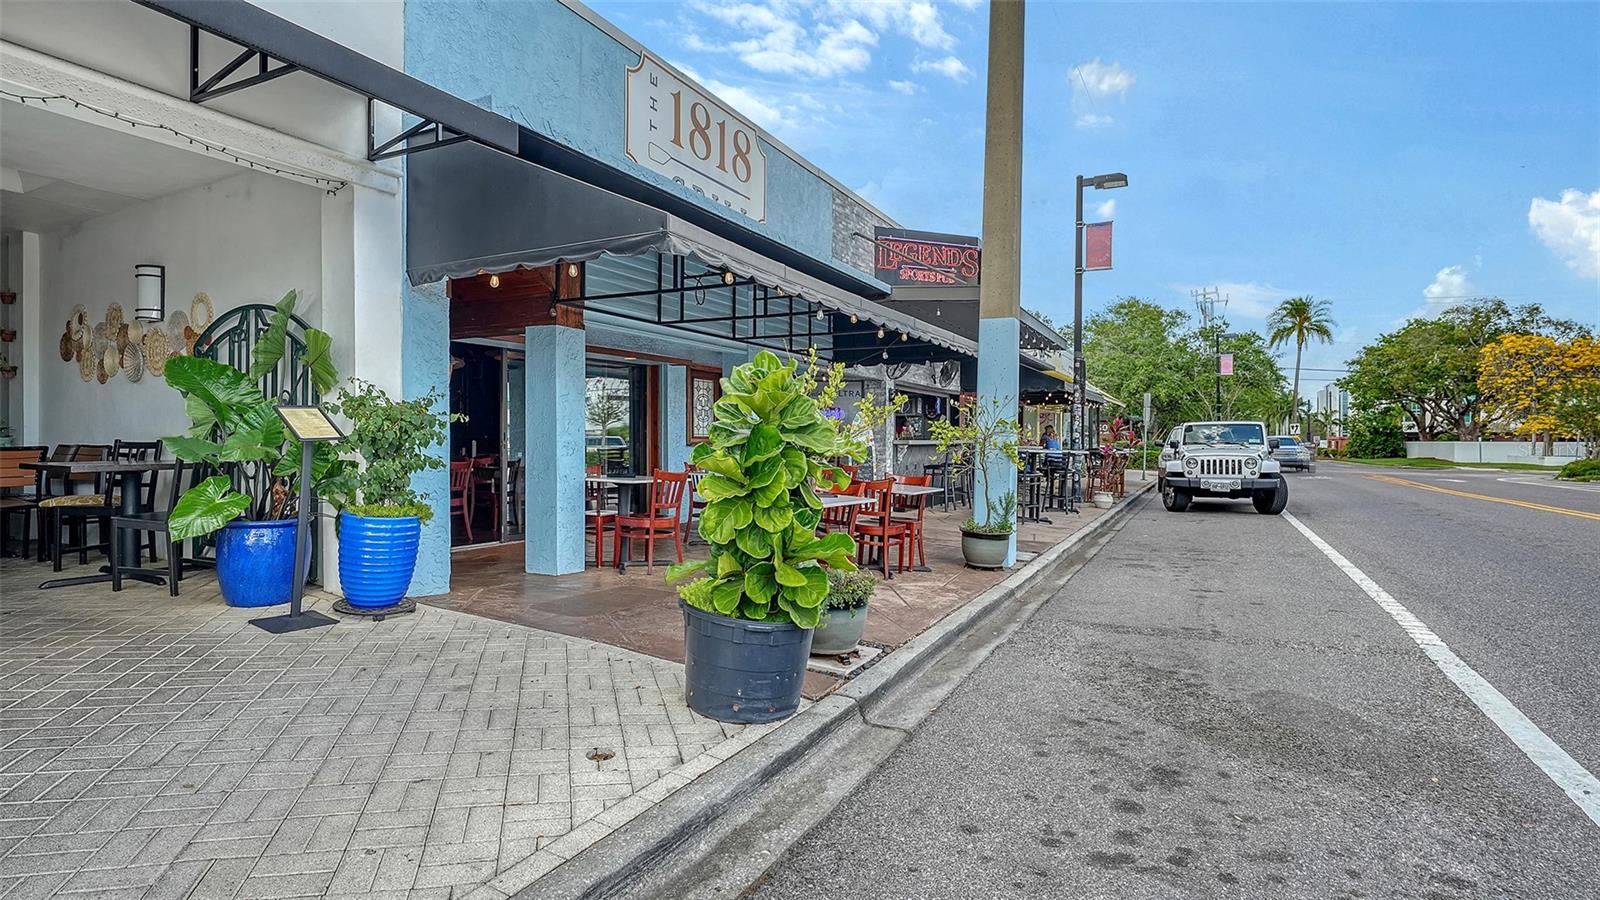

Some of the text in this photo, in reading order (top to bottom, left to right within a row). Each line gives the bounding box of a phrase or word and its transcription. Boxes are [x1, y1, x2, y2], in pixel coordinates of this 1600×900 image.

[649, 72, 659, 132] THE
[670, 90, 752, 184] 1818
[877, 240, 979, 278] LEGENDS
[837, 390, 861, 398] LTRA
